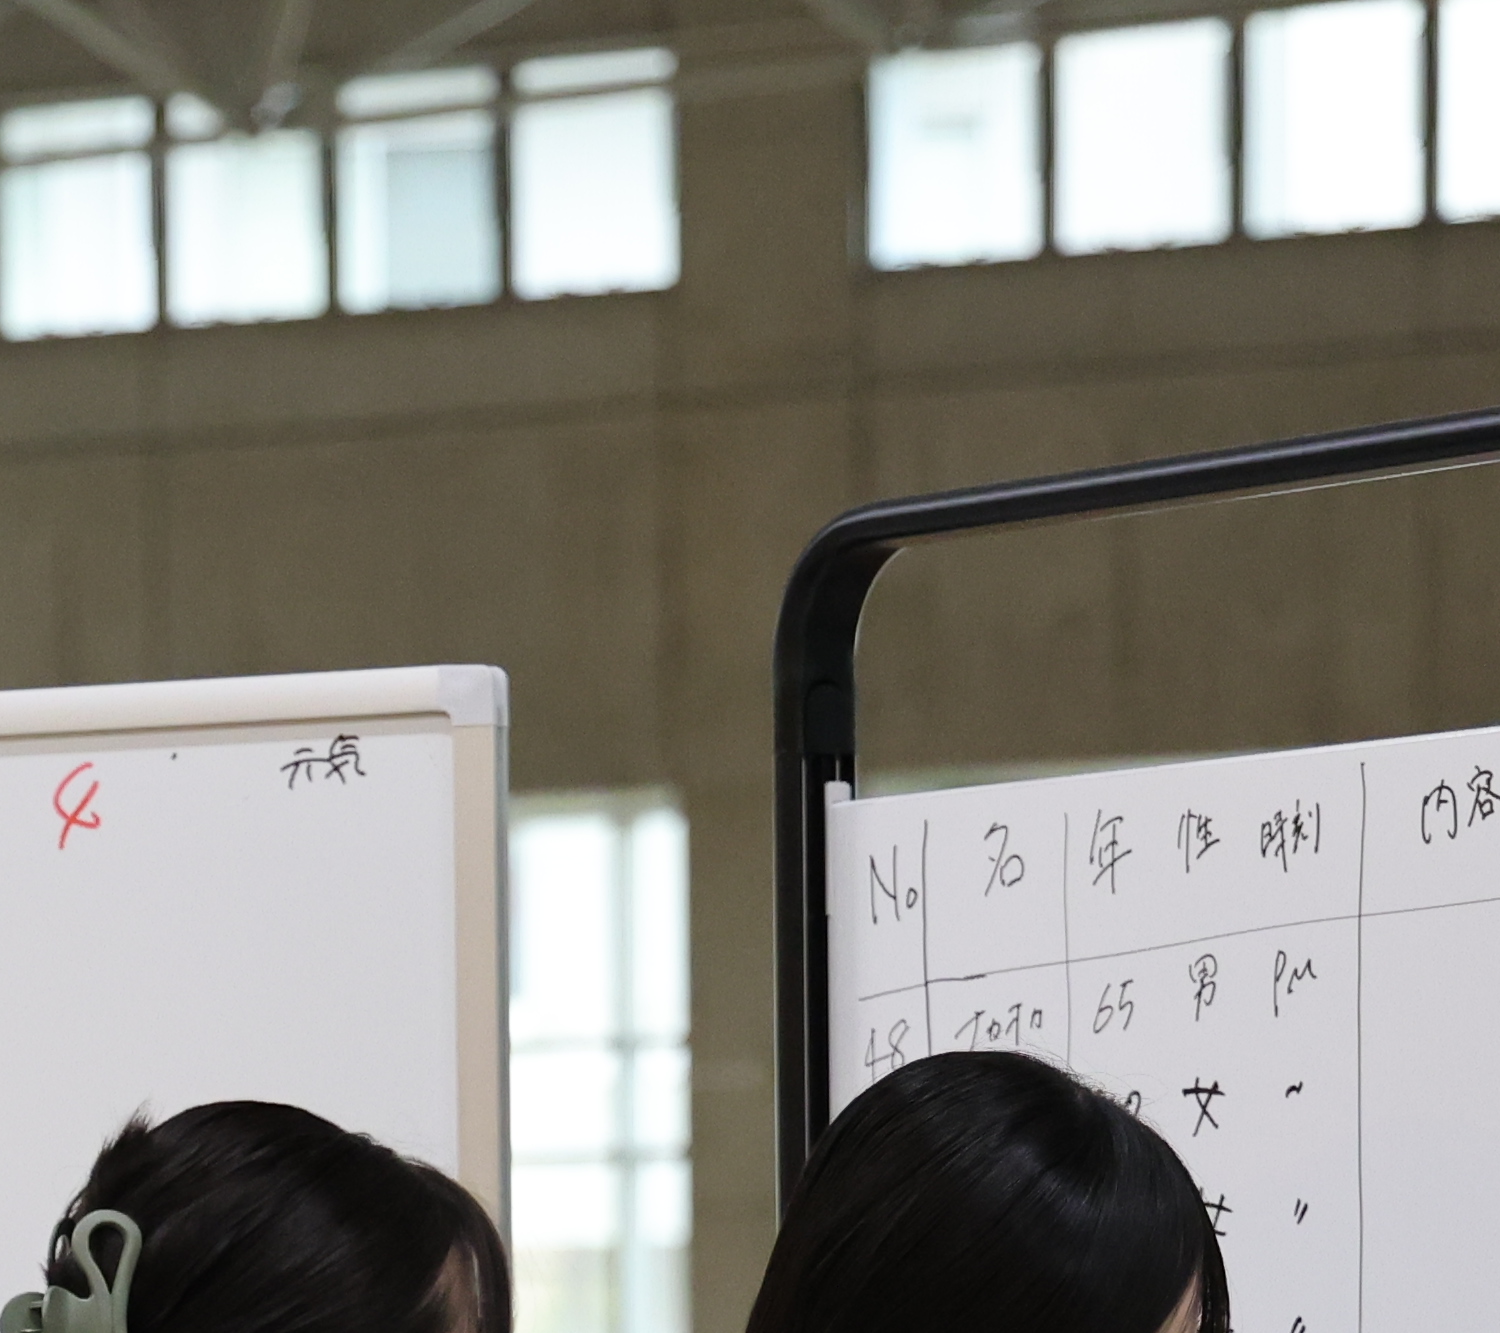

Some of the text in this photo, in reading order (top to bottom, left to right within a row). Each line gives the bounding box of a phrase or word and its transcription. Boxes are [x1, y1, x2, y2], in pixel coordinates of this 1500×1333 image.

[280, 733, 367, 790] 元気
[53, 761, 102, 850] 4
[984, 822, 1025, 897] 名
[1089, 809, 1133, 895] 年
[1177, 808, 1221, 874] 性
[1260, 799, 1321, 873] 時刻
[1093, 978, 1135, 1034] 65
[1189, 953, 1219, 1022] 男
